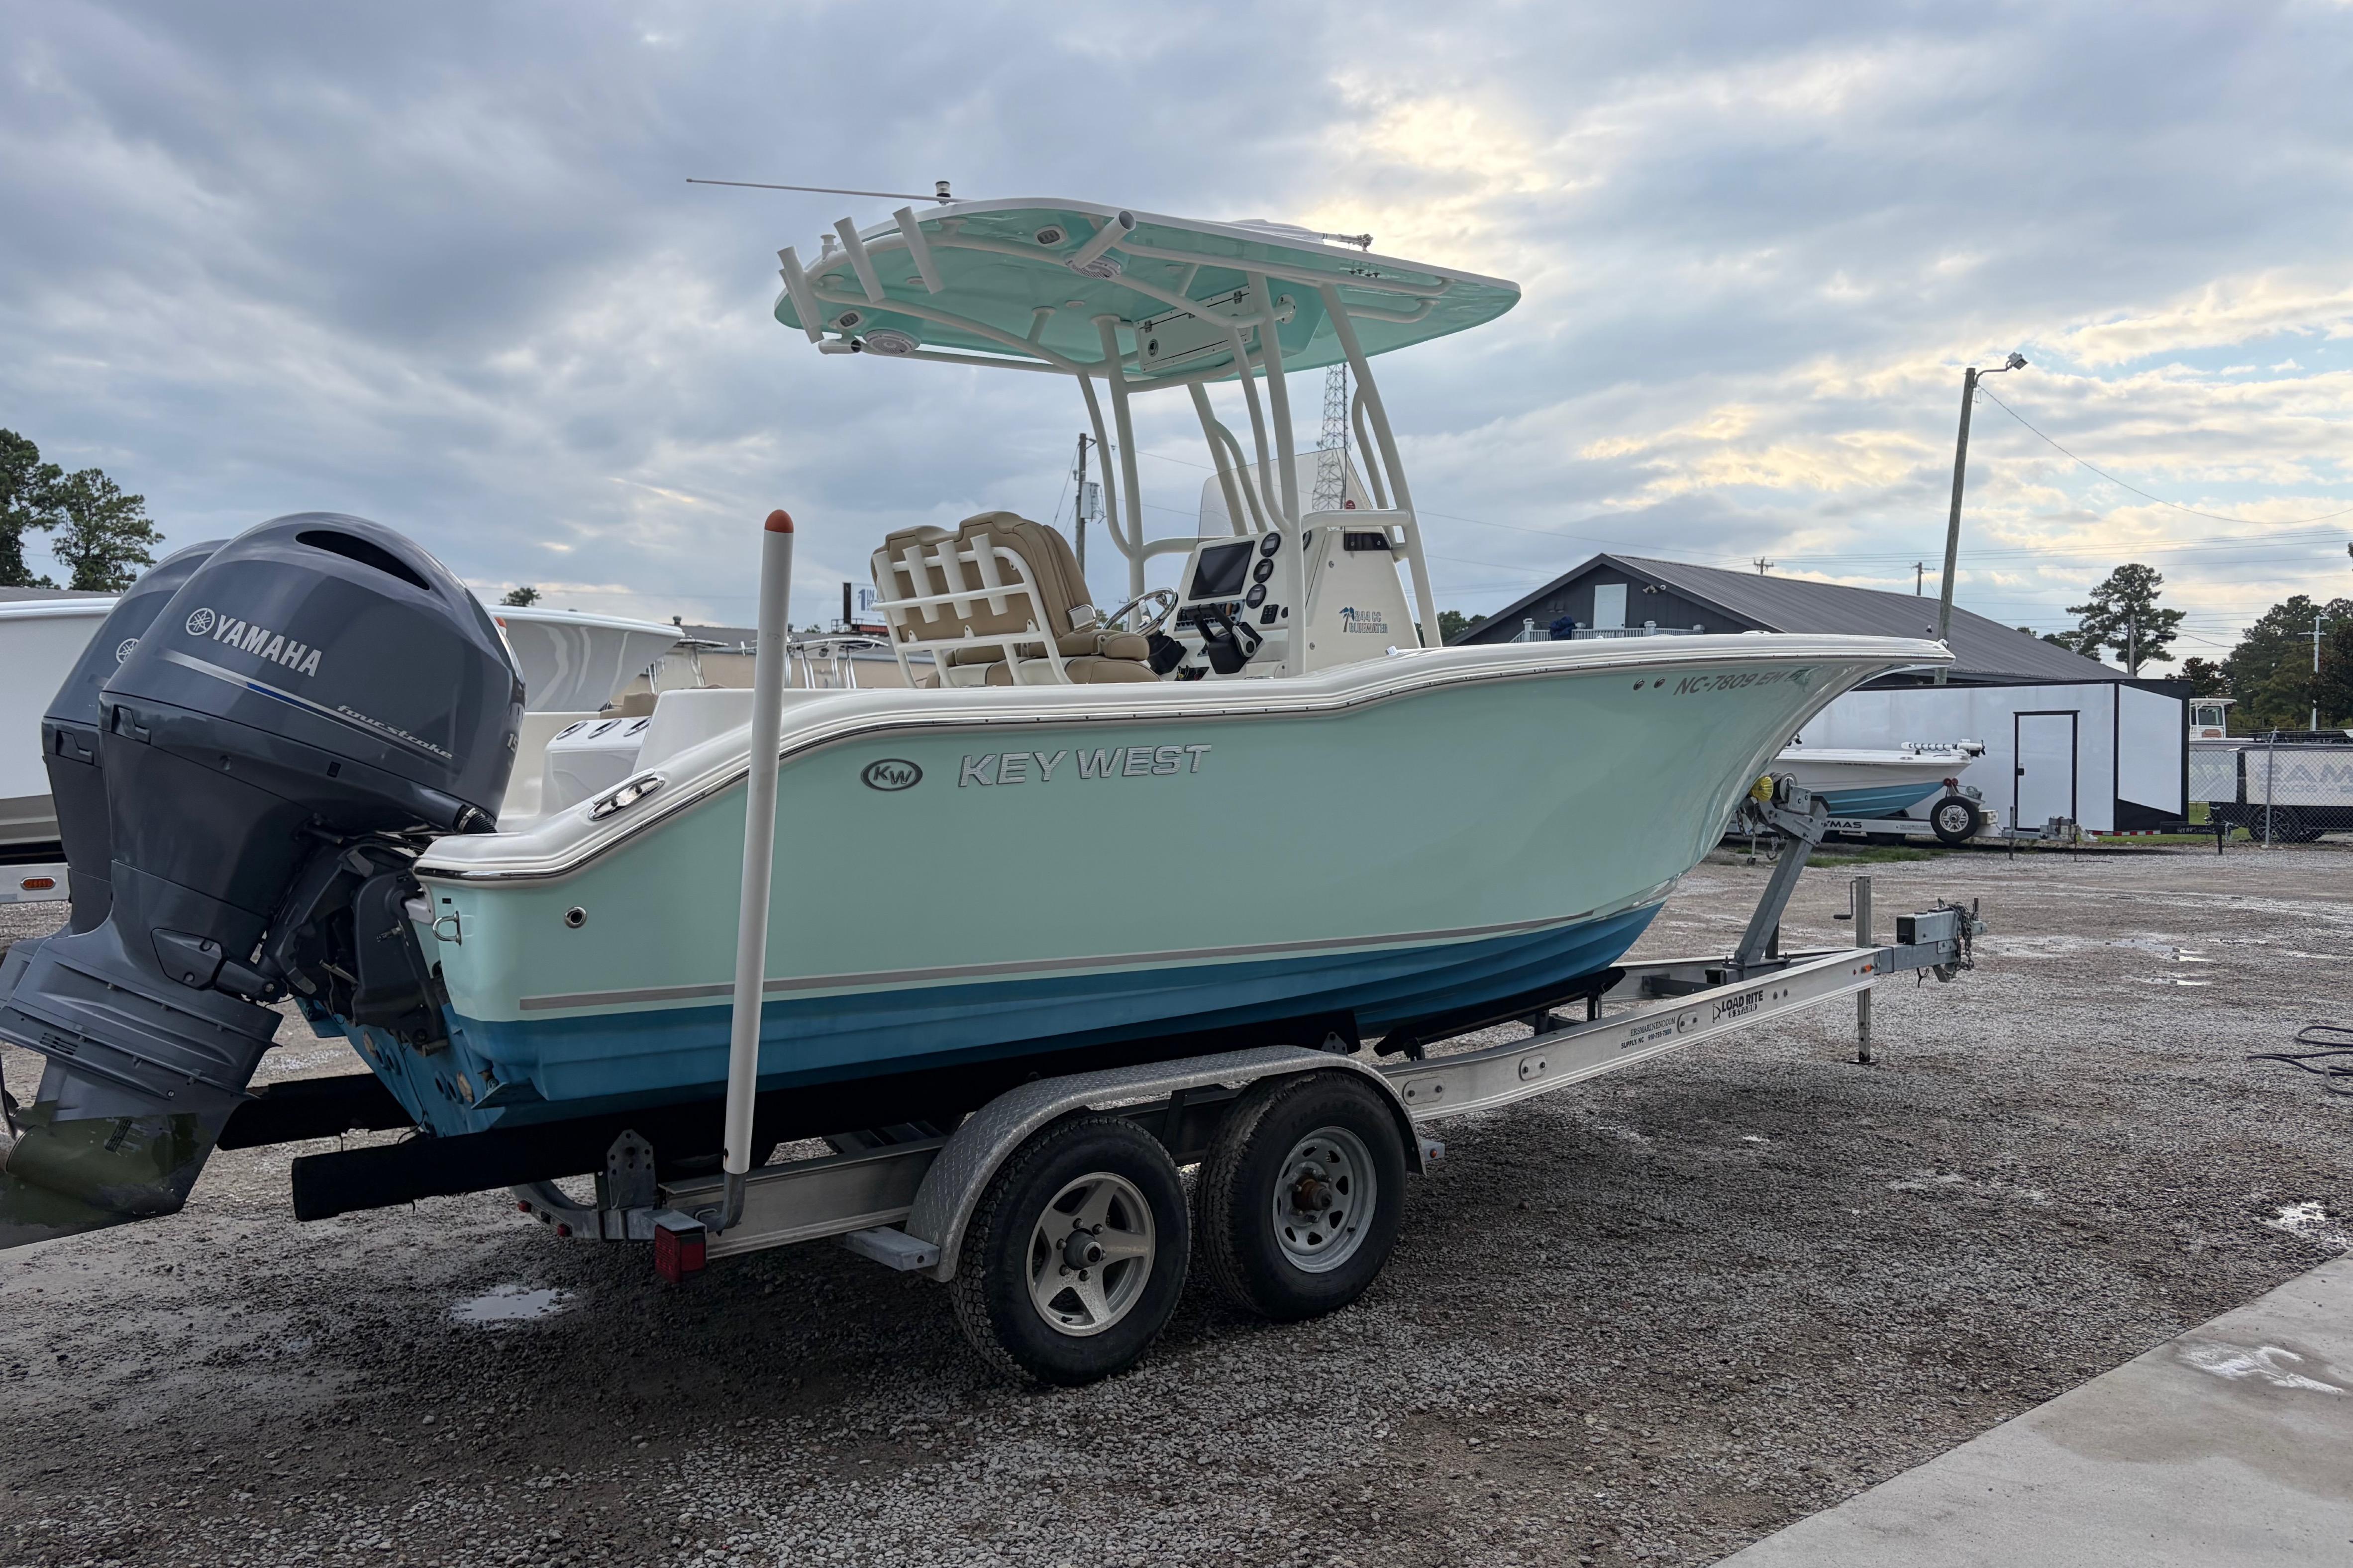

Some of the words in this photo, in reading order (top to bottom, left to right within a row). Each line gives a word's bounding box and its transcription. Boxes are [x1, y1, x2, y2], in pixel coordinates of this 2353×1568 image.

[1372, 611, 1382, 622] CC
[213, 614, 322, 677] YAMAHA
[873, 765, 912, 784] KW
[958, 750, 1068, 787] KEY
[1076, 744, 1212, 779] WEST
[1722, 996, 1744, 1012] LOAD
[1746, 990, 1763, 1005] RITE
